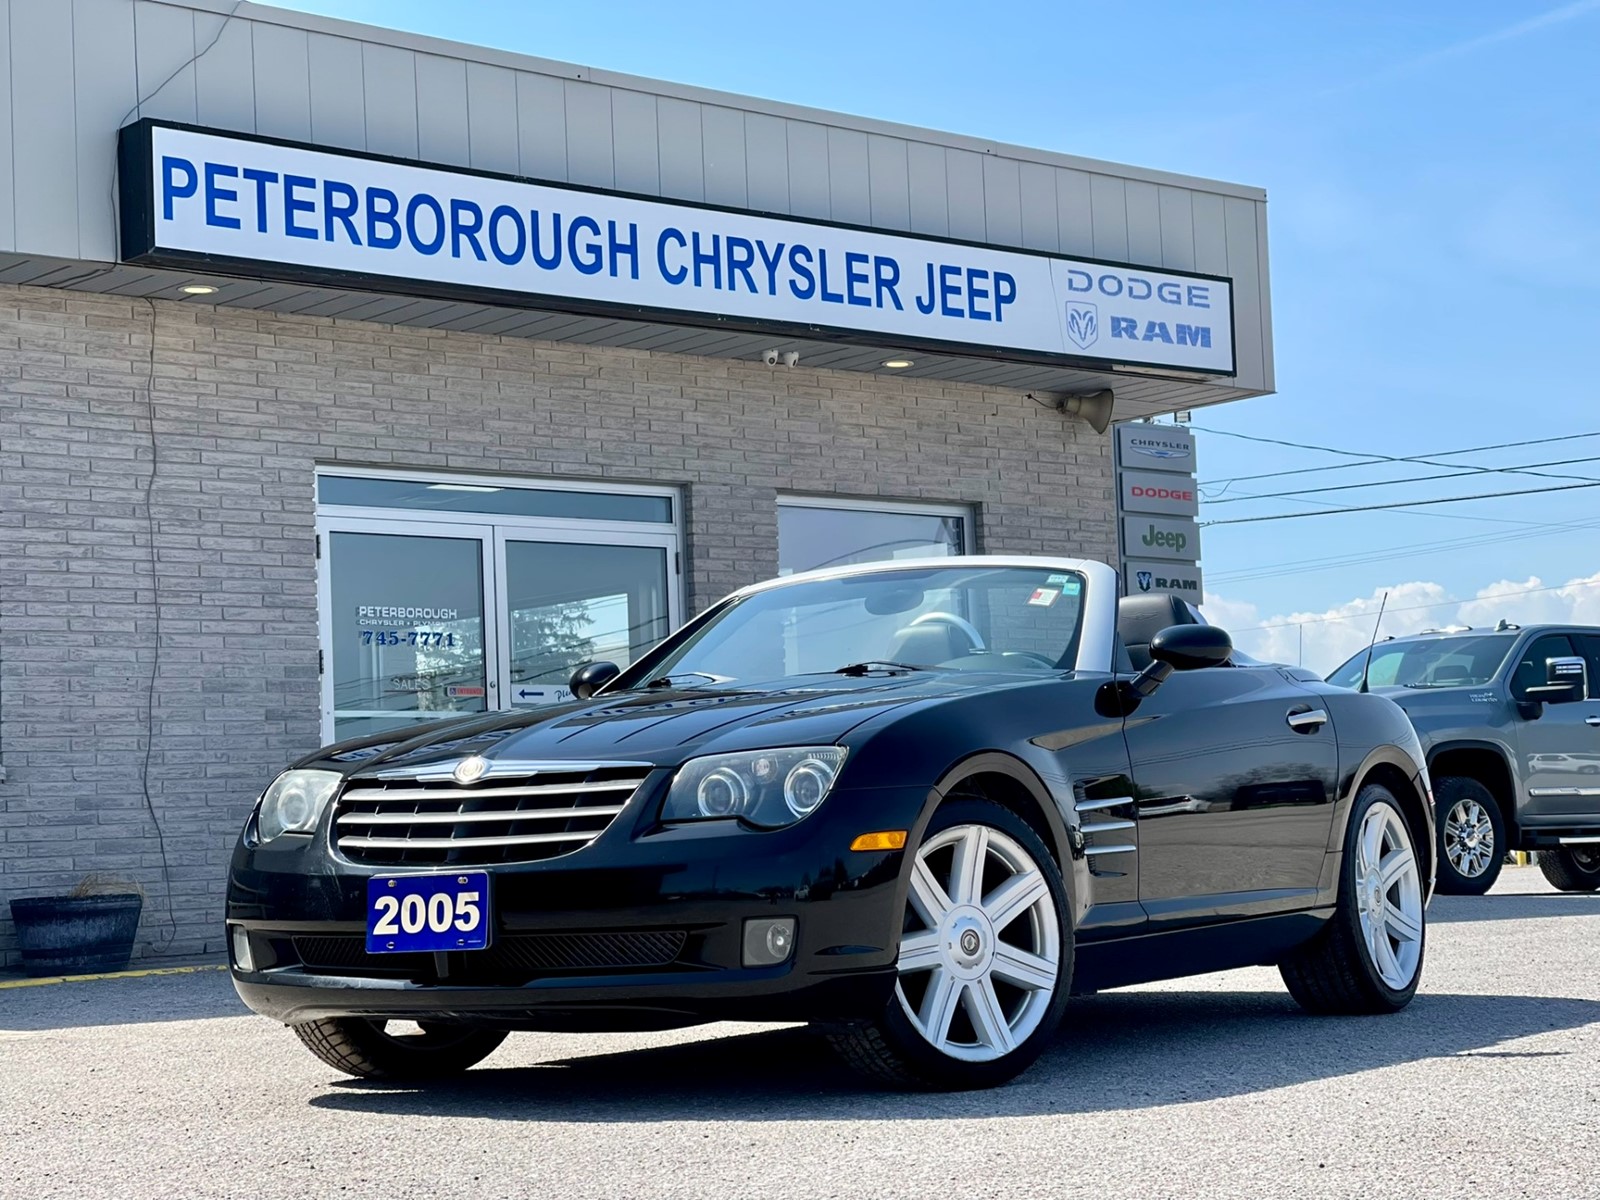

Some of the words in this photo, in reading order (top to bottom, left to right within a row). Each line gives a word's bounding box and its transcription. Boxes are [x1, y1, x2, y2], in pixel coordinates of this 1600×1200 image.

[162, 155, 639, 280] PETERBOROUGH
[656, 227, 905, 312] CHRYSLER
[915, 262, 1017, 323] JEEP
[1067, 269, 1211, 309] DODGE
[1110, 315, 1212, 349] RAM
[1130, 438, 1190, 450] CHRYSLER
[1131, 486, 1193, 501] DODGE
[1142, 524, 1187, 552] Jeep
[1155, 577, 1198, 590] RAM
[359, 606, 458, 619] PETERBOROUGH
[359, 619, 405, 627] CHRYSLER
[362, 630, 455, 647] 745-7771
[392, 678, 432, 691] SALES
[372, 891, 481, 936] 2005
